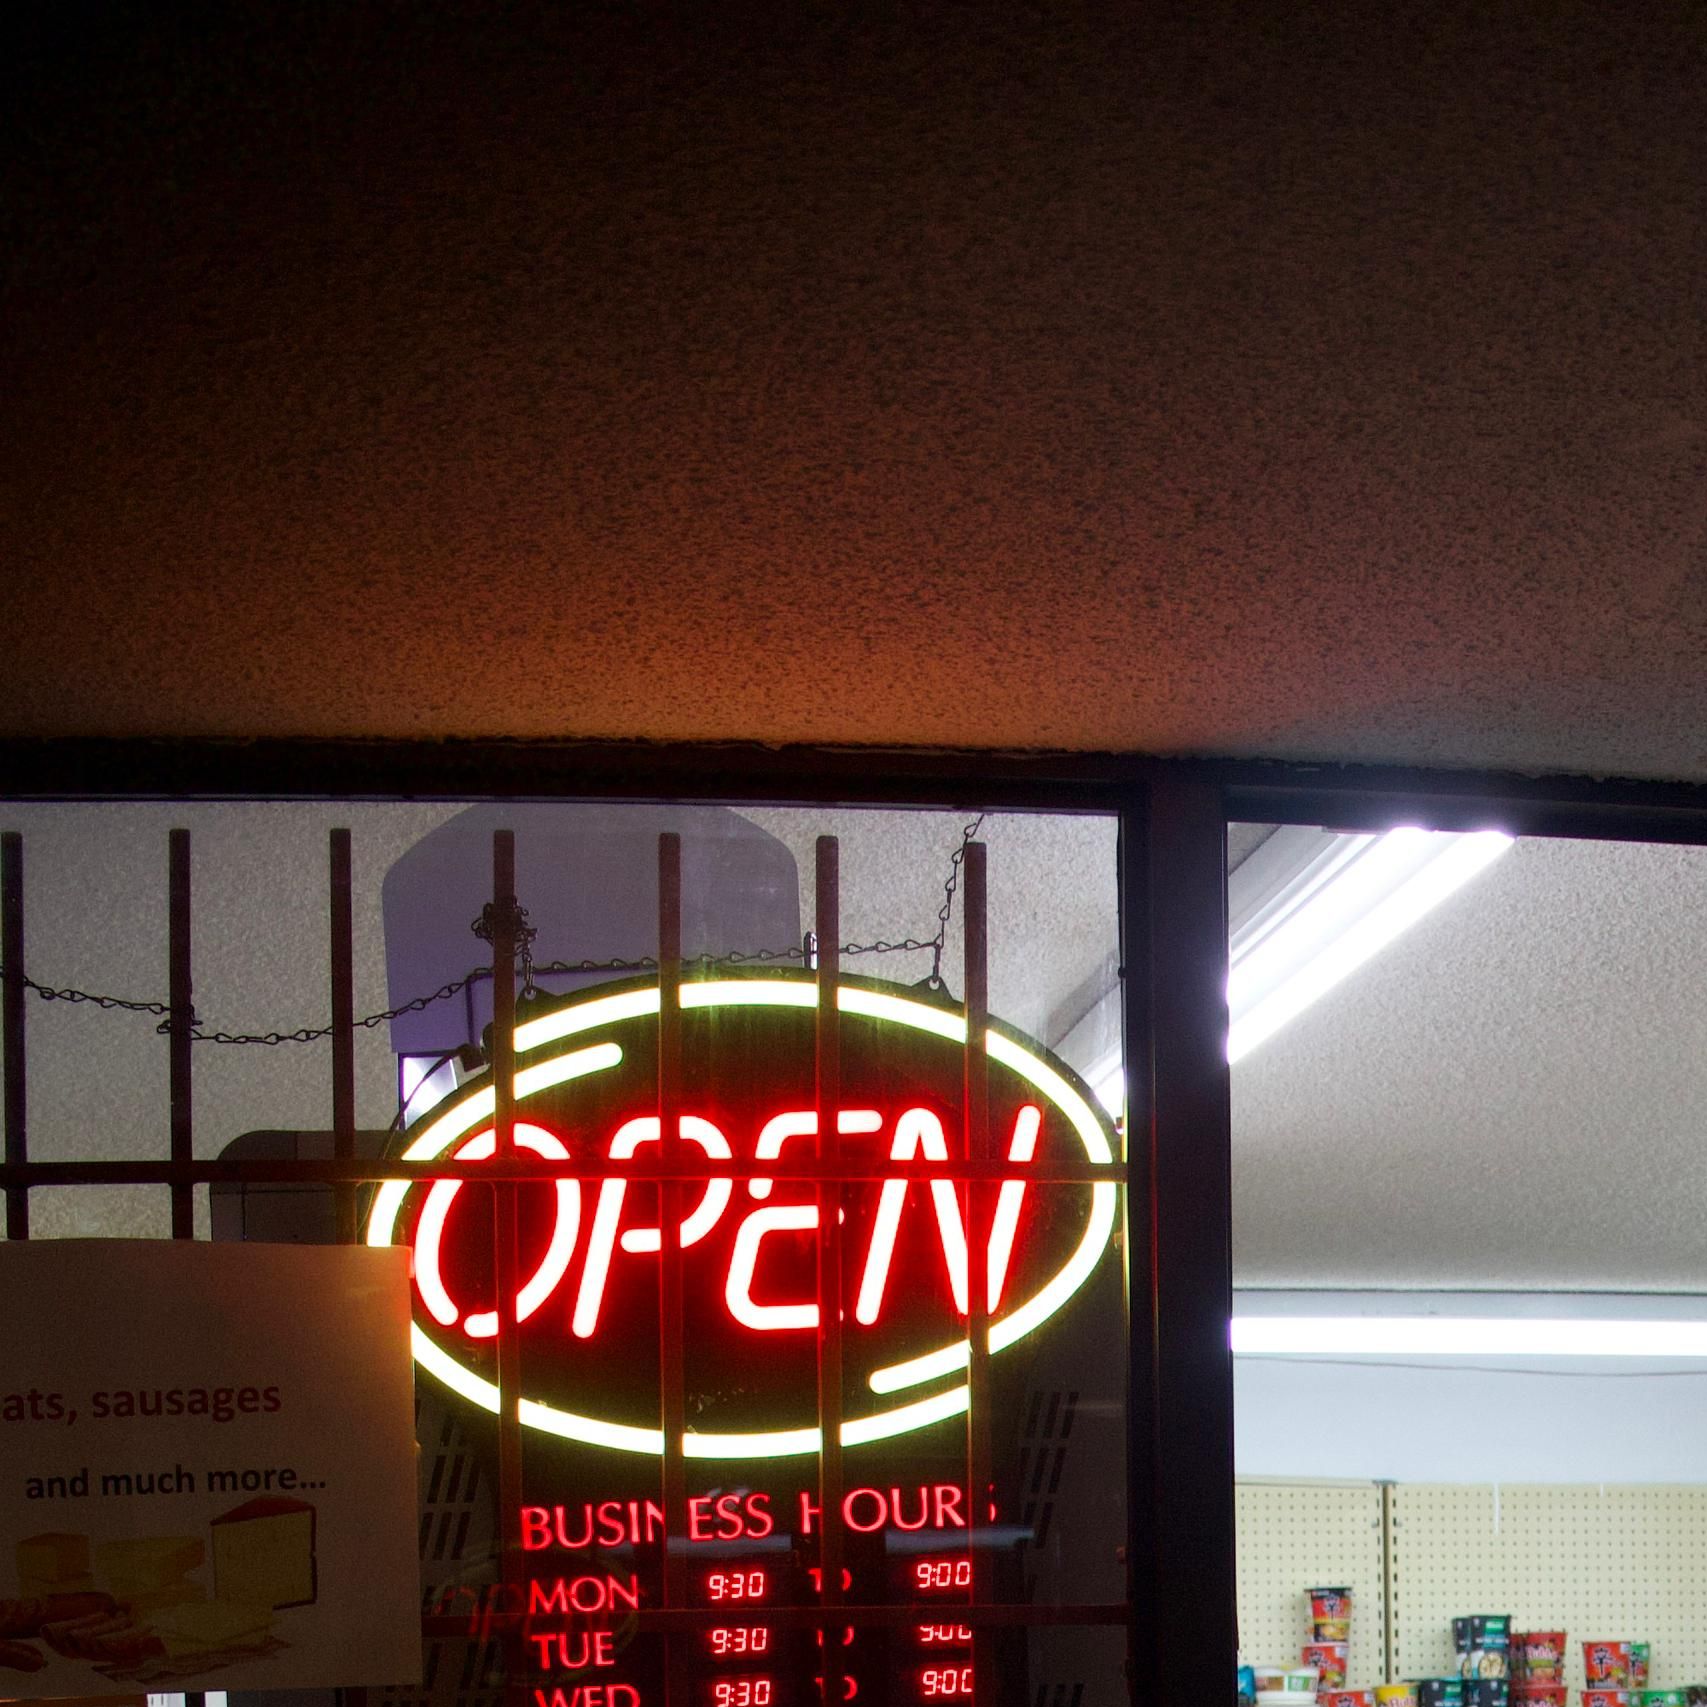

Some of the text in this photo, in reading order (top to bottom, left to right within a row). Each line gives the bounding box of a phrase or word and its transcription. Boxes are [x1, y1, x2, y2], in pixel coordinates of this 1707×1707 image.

[414, 1105, 1041, 1339] OPEN
[92, 1386, 281, 1422] sausages
[26, 1464, 326, 1499] and much more...
[800, 1484, 996, 1533] HOUR
[529, 1561, 971, 1613] MON 9:30 9:00
[532, 1628, 767, 1670] TUE 9:30
